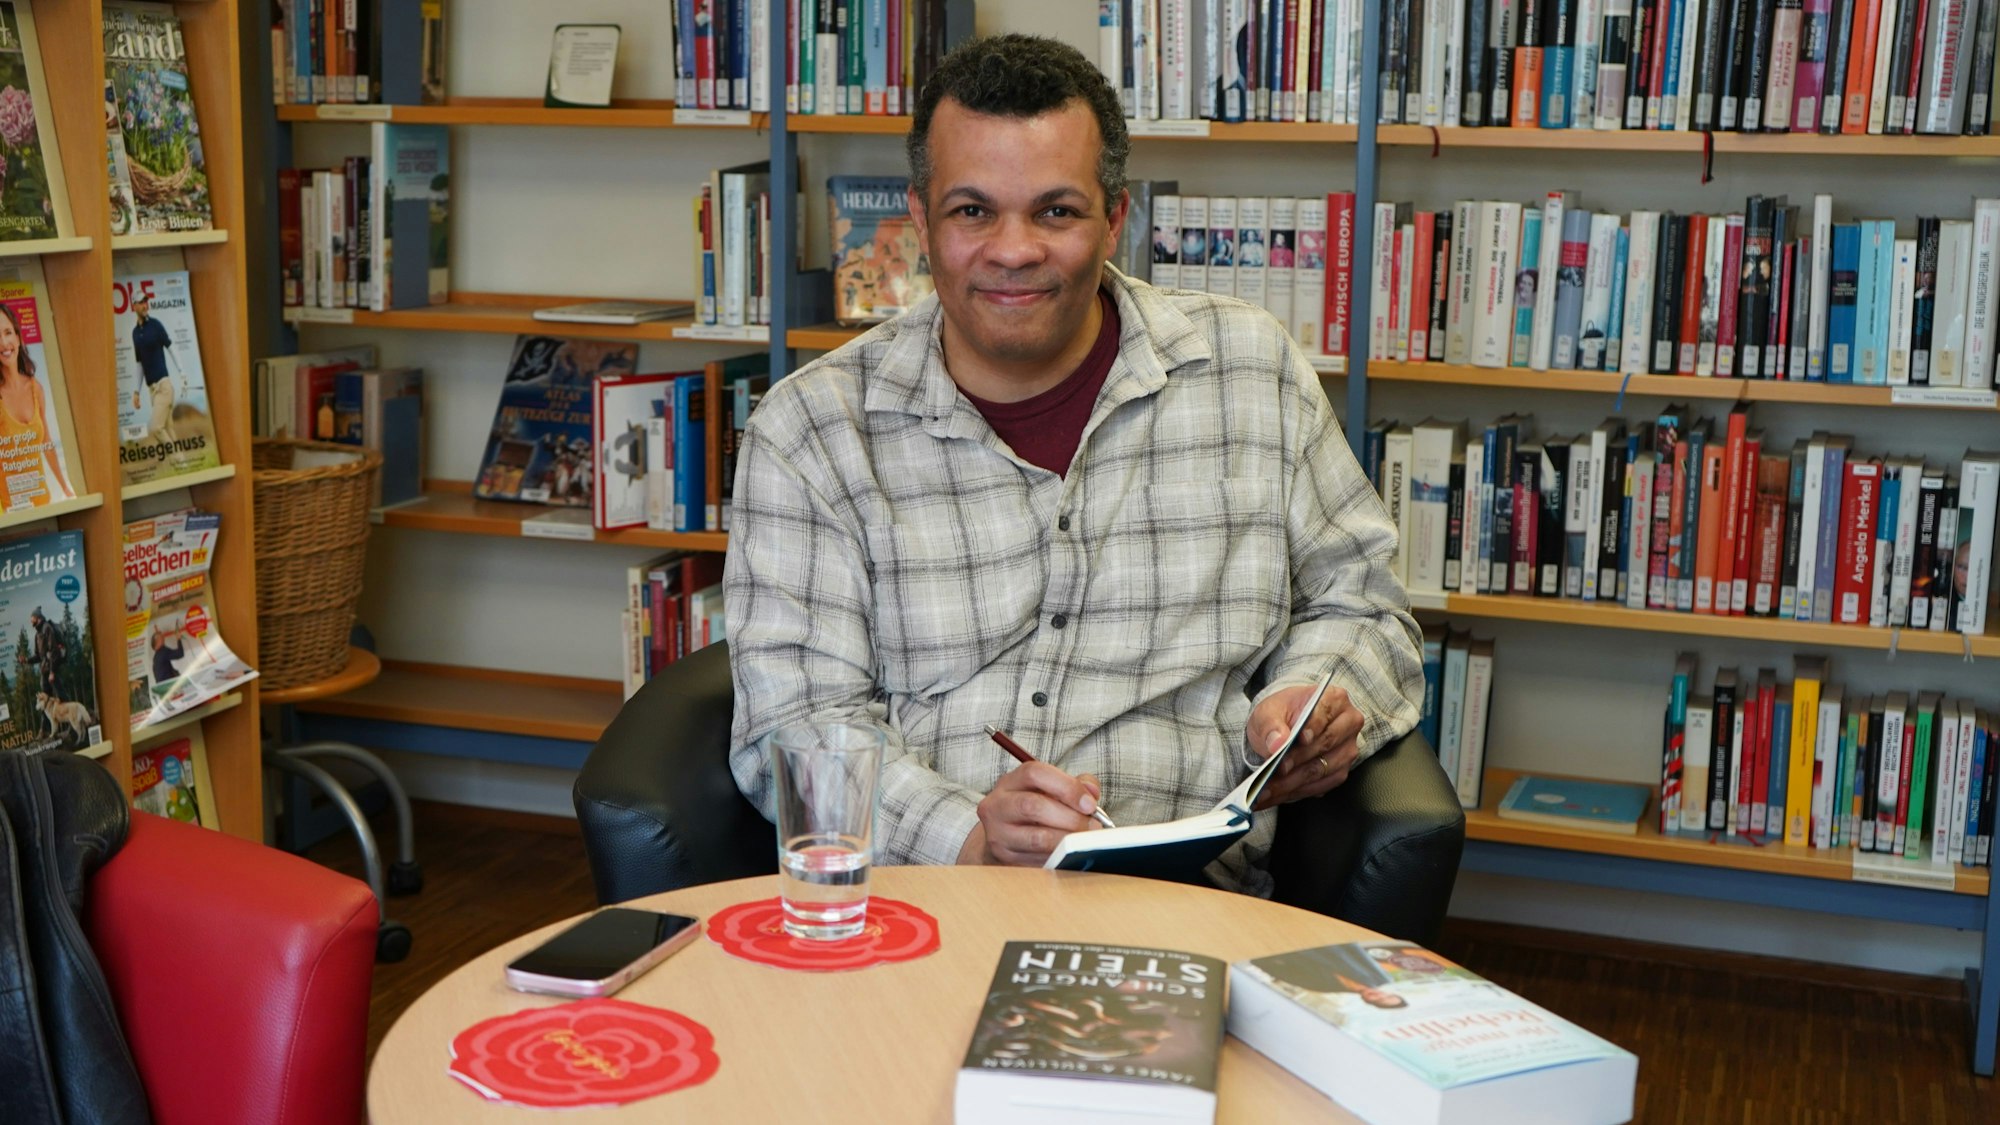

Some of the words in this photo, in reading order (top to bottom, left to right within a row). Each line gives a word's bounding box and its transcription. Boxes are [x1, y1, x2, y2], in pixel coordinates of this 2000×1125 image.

[1782, 41, 1793, 87] FRAUEN
[842, 191, 908, 209] HERZLAN
[141, 217, 167, 230] Erste
[168, 214, 204, 230] Blüten
[1338, 208, 1351, 268] EUROPA
[1975, 250, 1990, 316] BUNDESREPUBLIK
[150, 298, 187, 310] MAGAZIN
[1336, 271, 1349, 332] TYPISCH
[1973, 315, 1985, 330] DIE
[120, 434, 206, 465] Reisegenuss
[2, 458, 40, 472] Ratgeber
[1856, 479, 1873, 529] Merkel
[1, 548, 77, 583] derlust
[124, 550, 190, 580] machen
[1851, 531, 1870, 584] Angela
[1, 730, 34, 749] NATUR
[1018, 949, 1209, 984] STEIN
[1011, 972, 1206, 1000] SCHLANGEN
[1382, 1009, 1546, 1041] Rebellin
[982, 1057, 1089, 1073] SULLIVAN
[1124, 1065, 1196, 1085] JAMES
